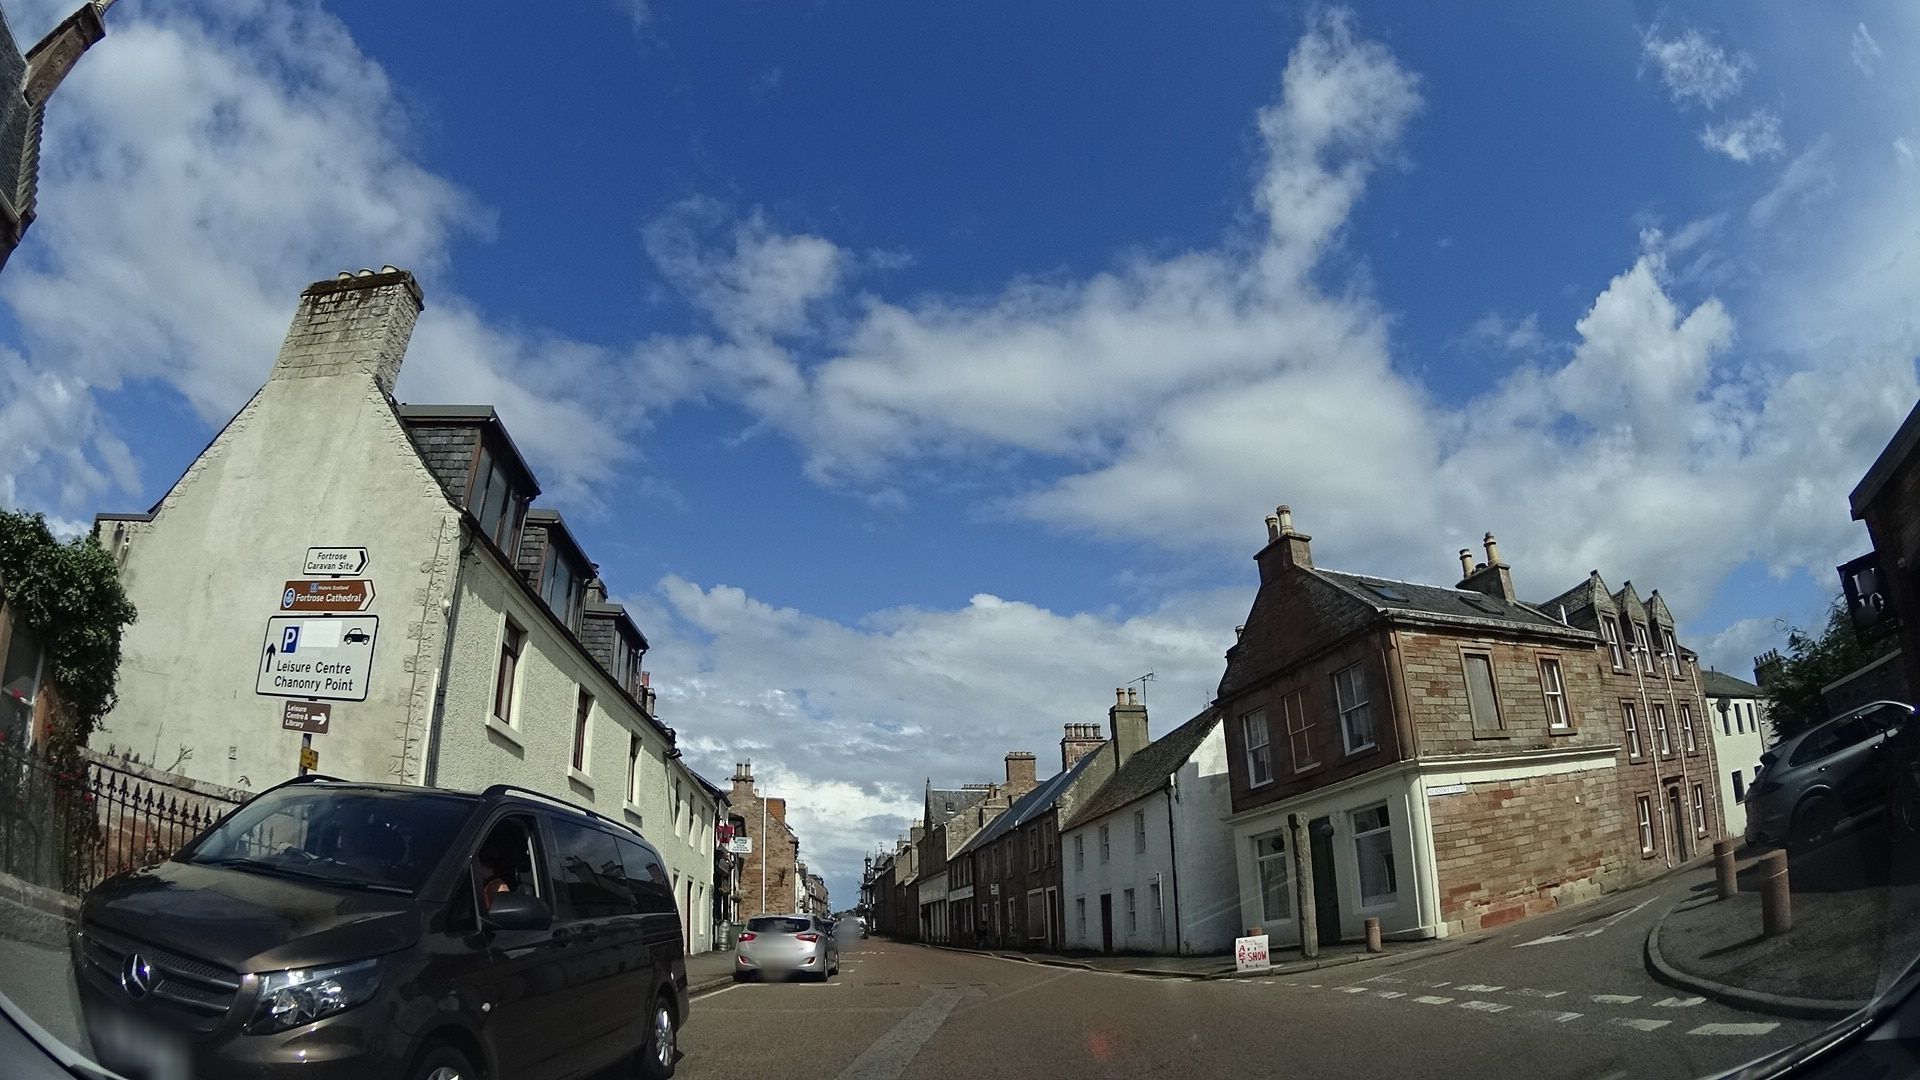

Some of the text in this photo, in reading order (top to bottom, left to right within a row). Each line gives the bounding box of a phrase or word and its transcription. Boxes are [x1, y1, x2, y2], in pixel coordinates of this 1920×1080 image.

[317, 552, 347, 560] Fortrose
[307, 561, 353, 570] Caravan Site
[296, 593, 361, 602] Fortrose Cathedral
[282, 628, 297, 651] P
[277, 660, 351, 674] Leisure Centre
[274, 675, 353, 692] Chanonry Point
[287, 704, 307, 712] Leisure
[286, 711, 304, 720] Centre
[285, 719, 304, 728] Library
[1238, 945, 1246, 964] ART
[1247, 951, 1267, 962] SHOW
